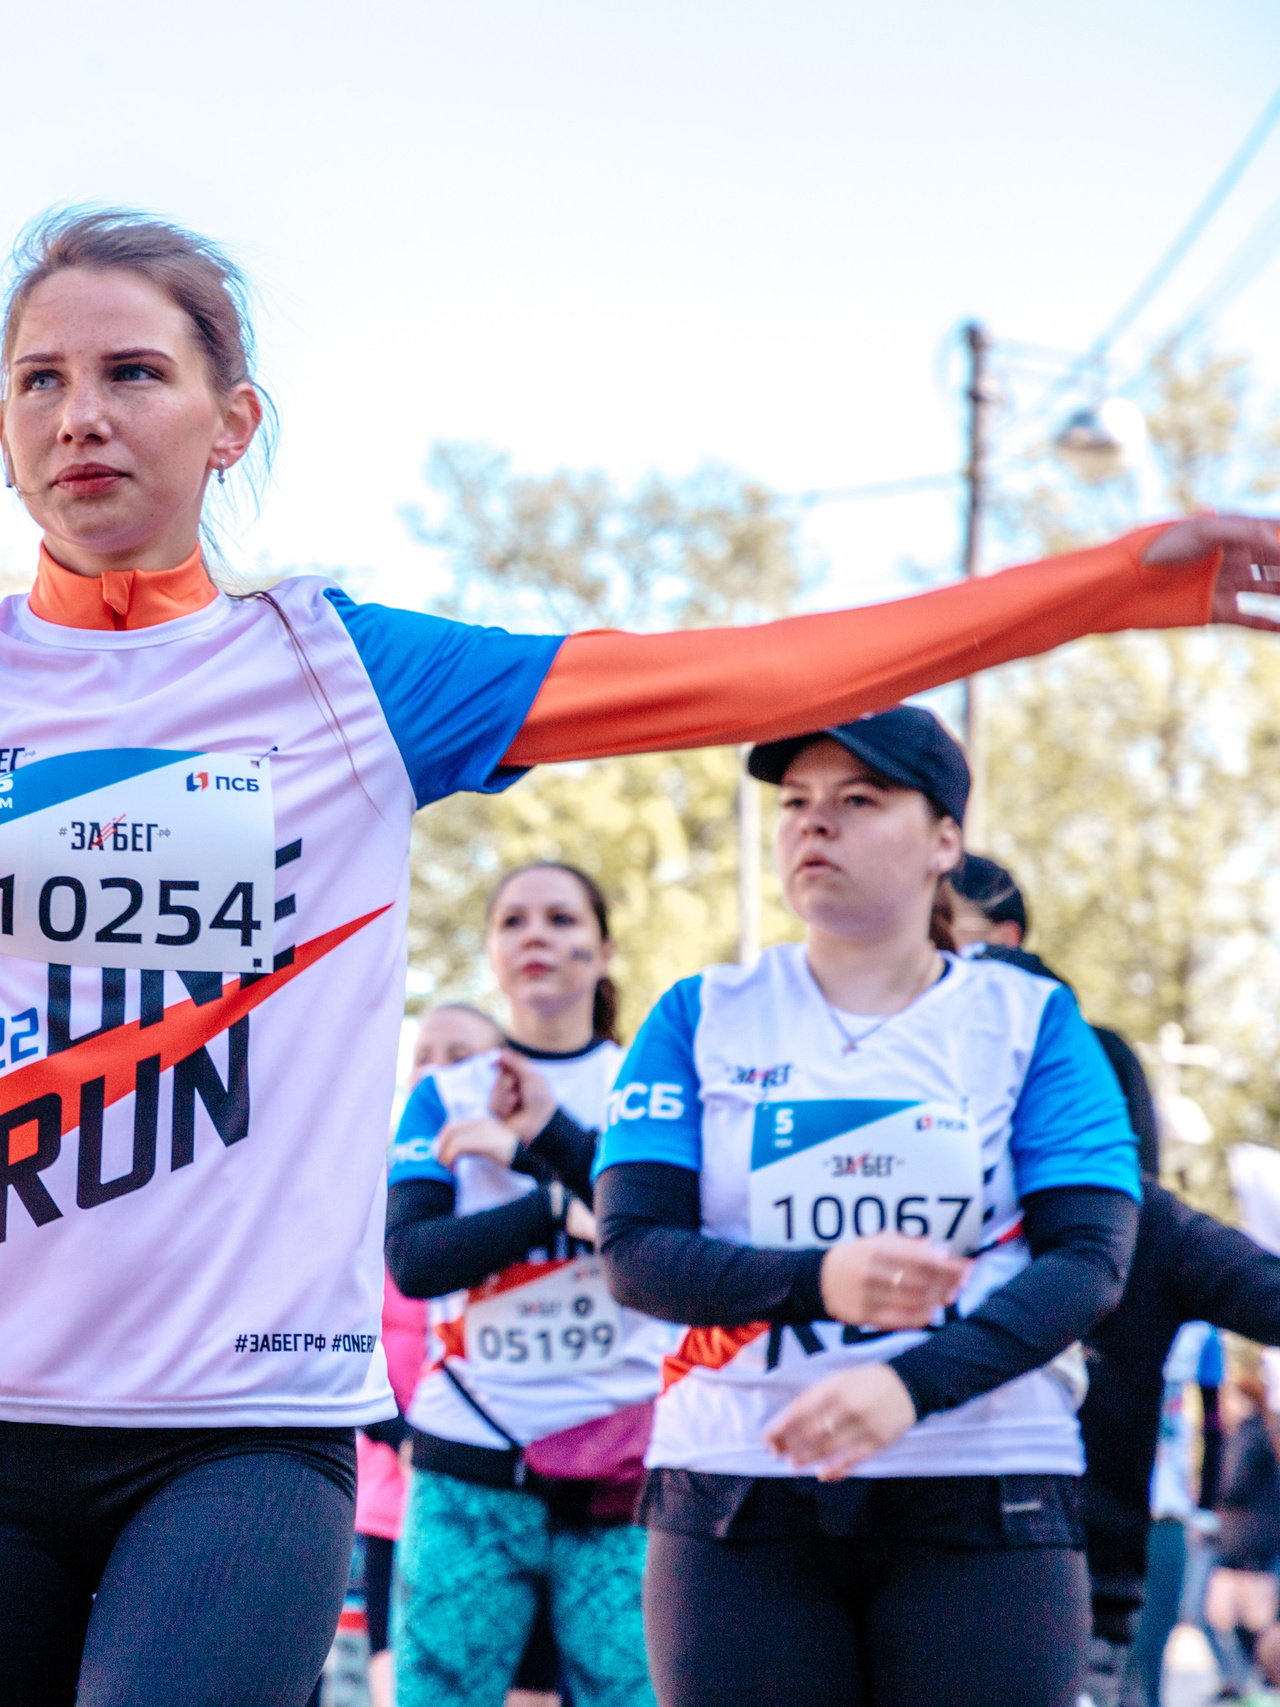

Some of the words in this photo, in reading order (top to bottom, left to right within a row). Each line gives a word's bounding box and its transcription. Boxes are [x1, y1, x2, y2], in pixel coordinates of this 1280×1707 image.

[215, 775, 260, 792] ПСБ
[775, 1108, 794, 1135] 5
[773, 1195, 973, 1241] 10067
[234, 1333, 326, 1353] #ЗАБЕГРФ
[478, 1321, 615, 1364] 05199
